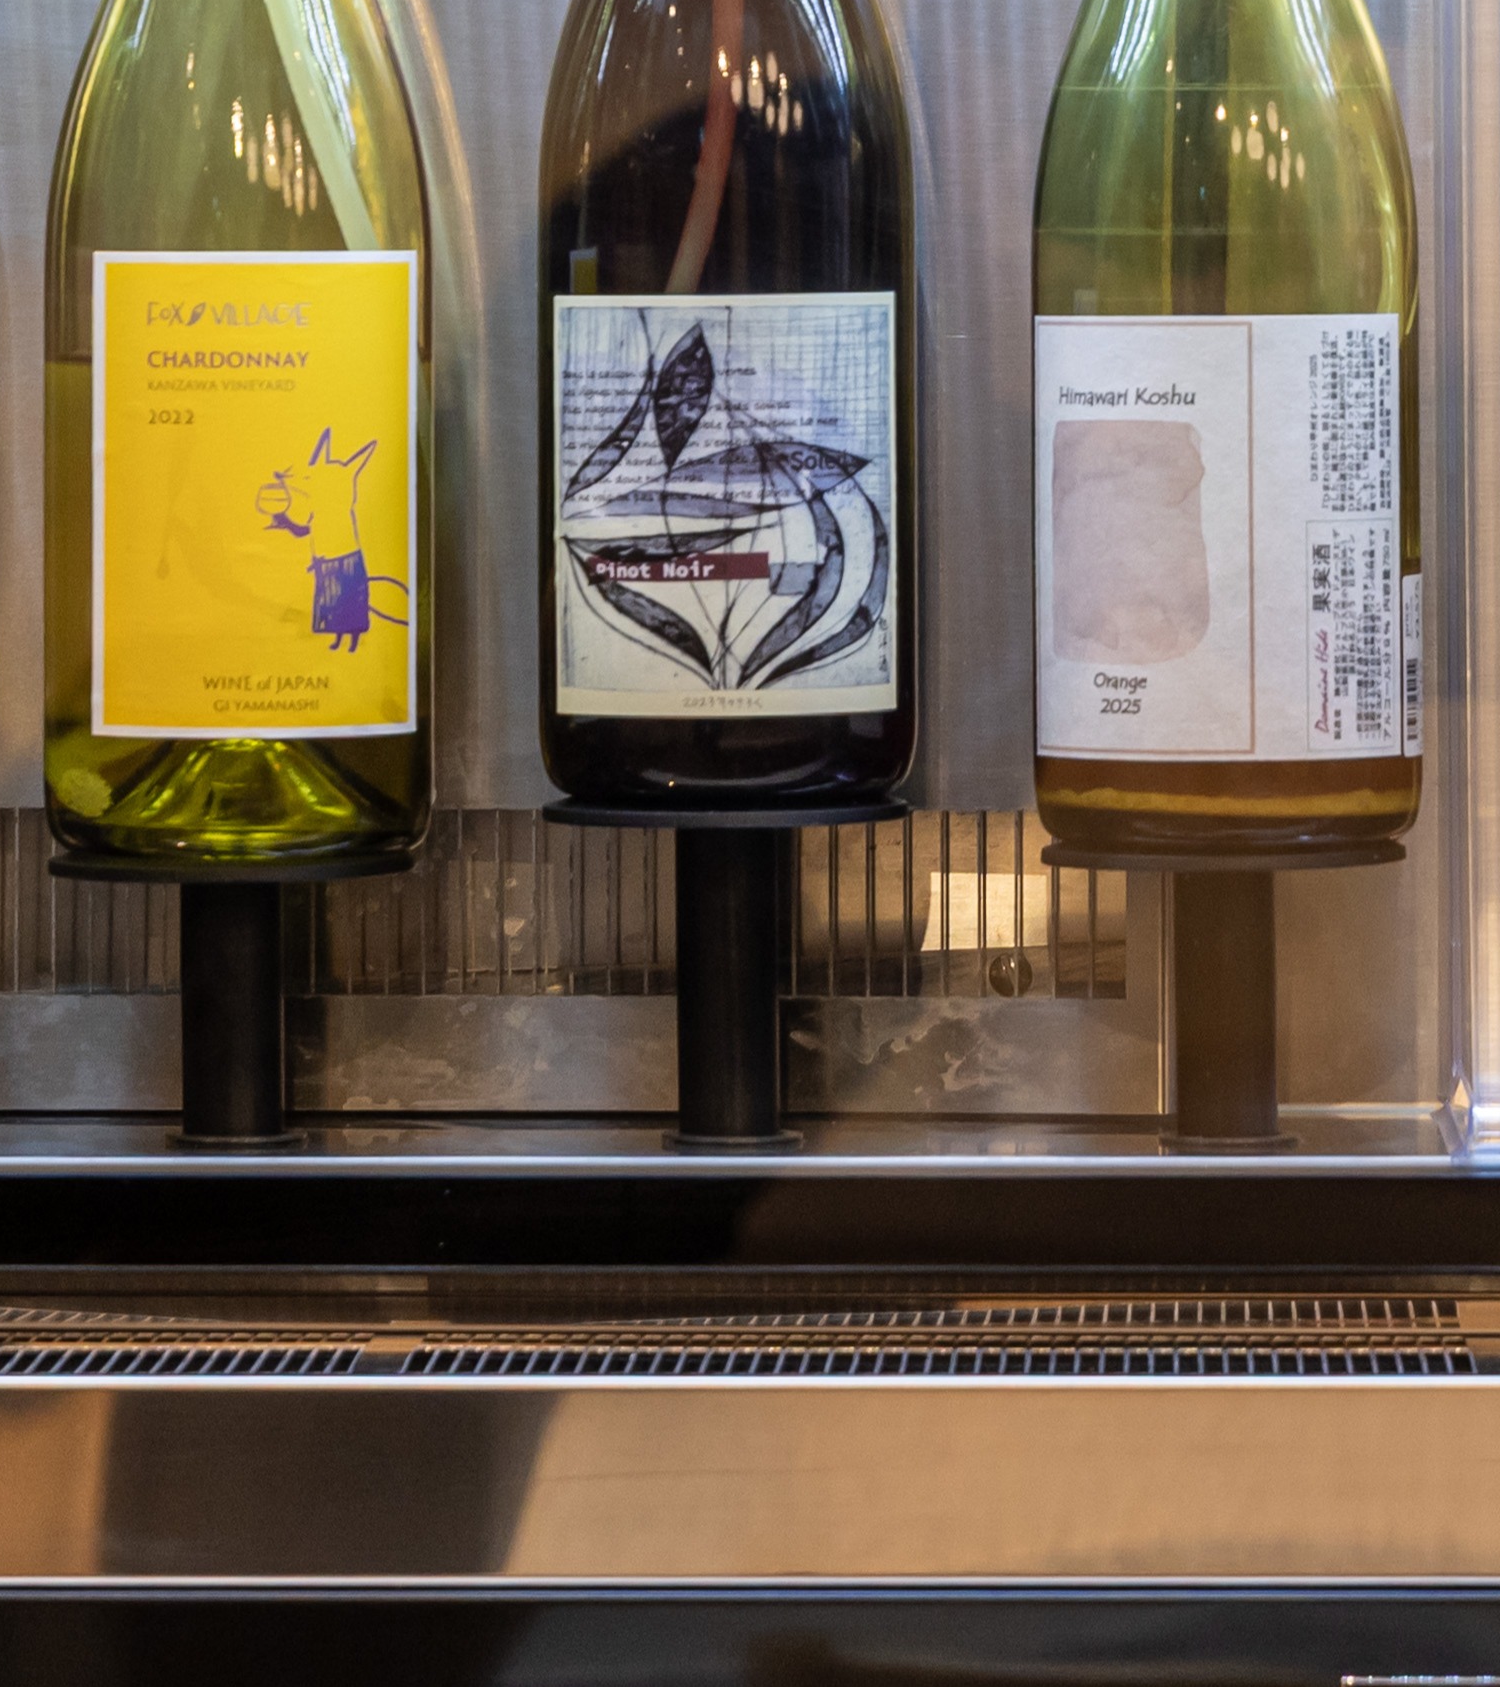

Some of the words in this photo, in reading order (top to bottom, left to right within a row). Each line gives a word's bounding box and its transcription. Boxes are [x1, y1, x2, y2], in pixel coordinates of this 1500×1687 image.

[147, 351, 310, 369] CHARDONNAY
[147, 379, 218, 392] KANZAWA
[221, 379, 296, 393] VINEYARD
[1059, 386, 1128, 407] Himawari
[1134, 383, 1197, 407] Koshu
[148, 409, 195, 426] 2022
[596, 558, 652, 580] Pinot
[662, 557, 715, 580] Noir
[1312, 544, 1331, 613] 果実酒
[203, 675, 252, 691] WINE
[256, 674, 273, 691] of
[275, 675, 330, 692] JAPAN
[1094, 673, 1148, 694] Orange
[212, 699, 231, 713] GI
[233, 698, 320, 713] YAMANASHI
[1100, 698, 1142, 715] 2025
